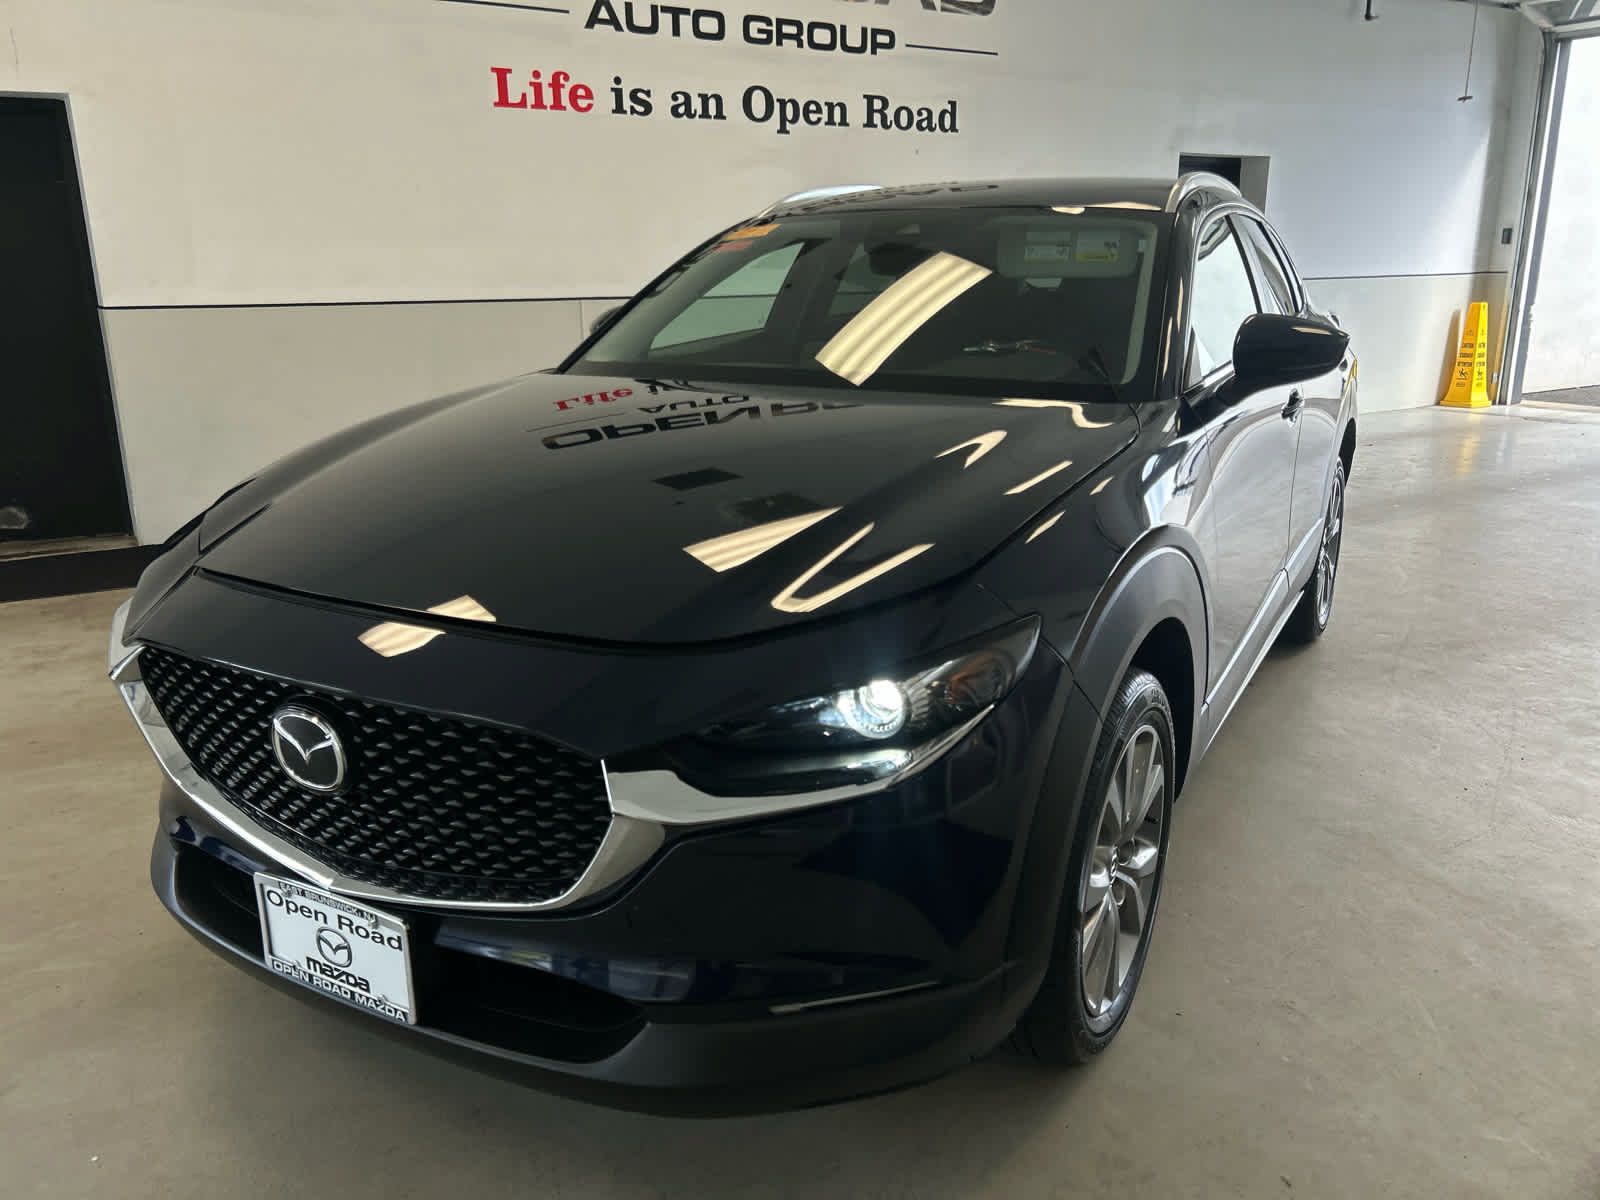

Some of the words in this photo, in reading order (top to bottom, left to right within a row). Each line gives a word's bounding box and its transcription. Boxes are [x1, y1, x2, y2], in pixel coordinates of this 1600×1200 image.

[584, 0, 726, 41] AUTO
[742, 14, 896, 56] GROUP
[490, 67, 595, 113] Life
[611, 76, 653, 117] is
[670, 87, 727, 121] an
[742, 84, 850, 135] Open
[863, 94, 959, 133] Road
[266, 889, 328, 925] Open
[337, 914, 403, 951] Road
[273, 960, 309, 982] OPEN
[313, 976, 350, 999] ROAD
[355, 994, 406, 1022] MAZDA
[306, 956, 371, 993] mazda
